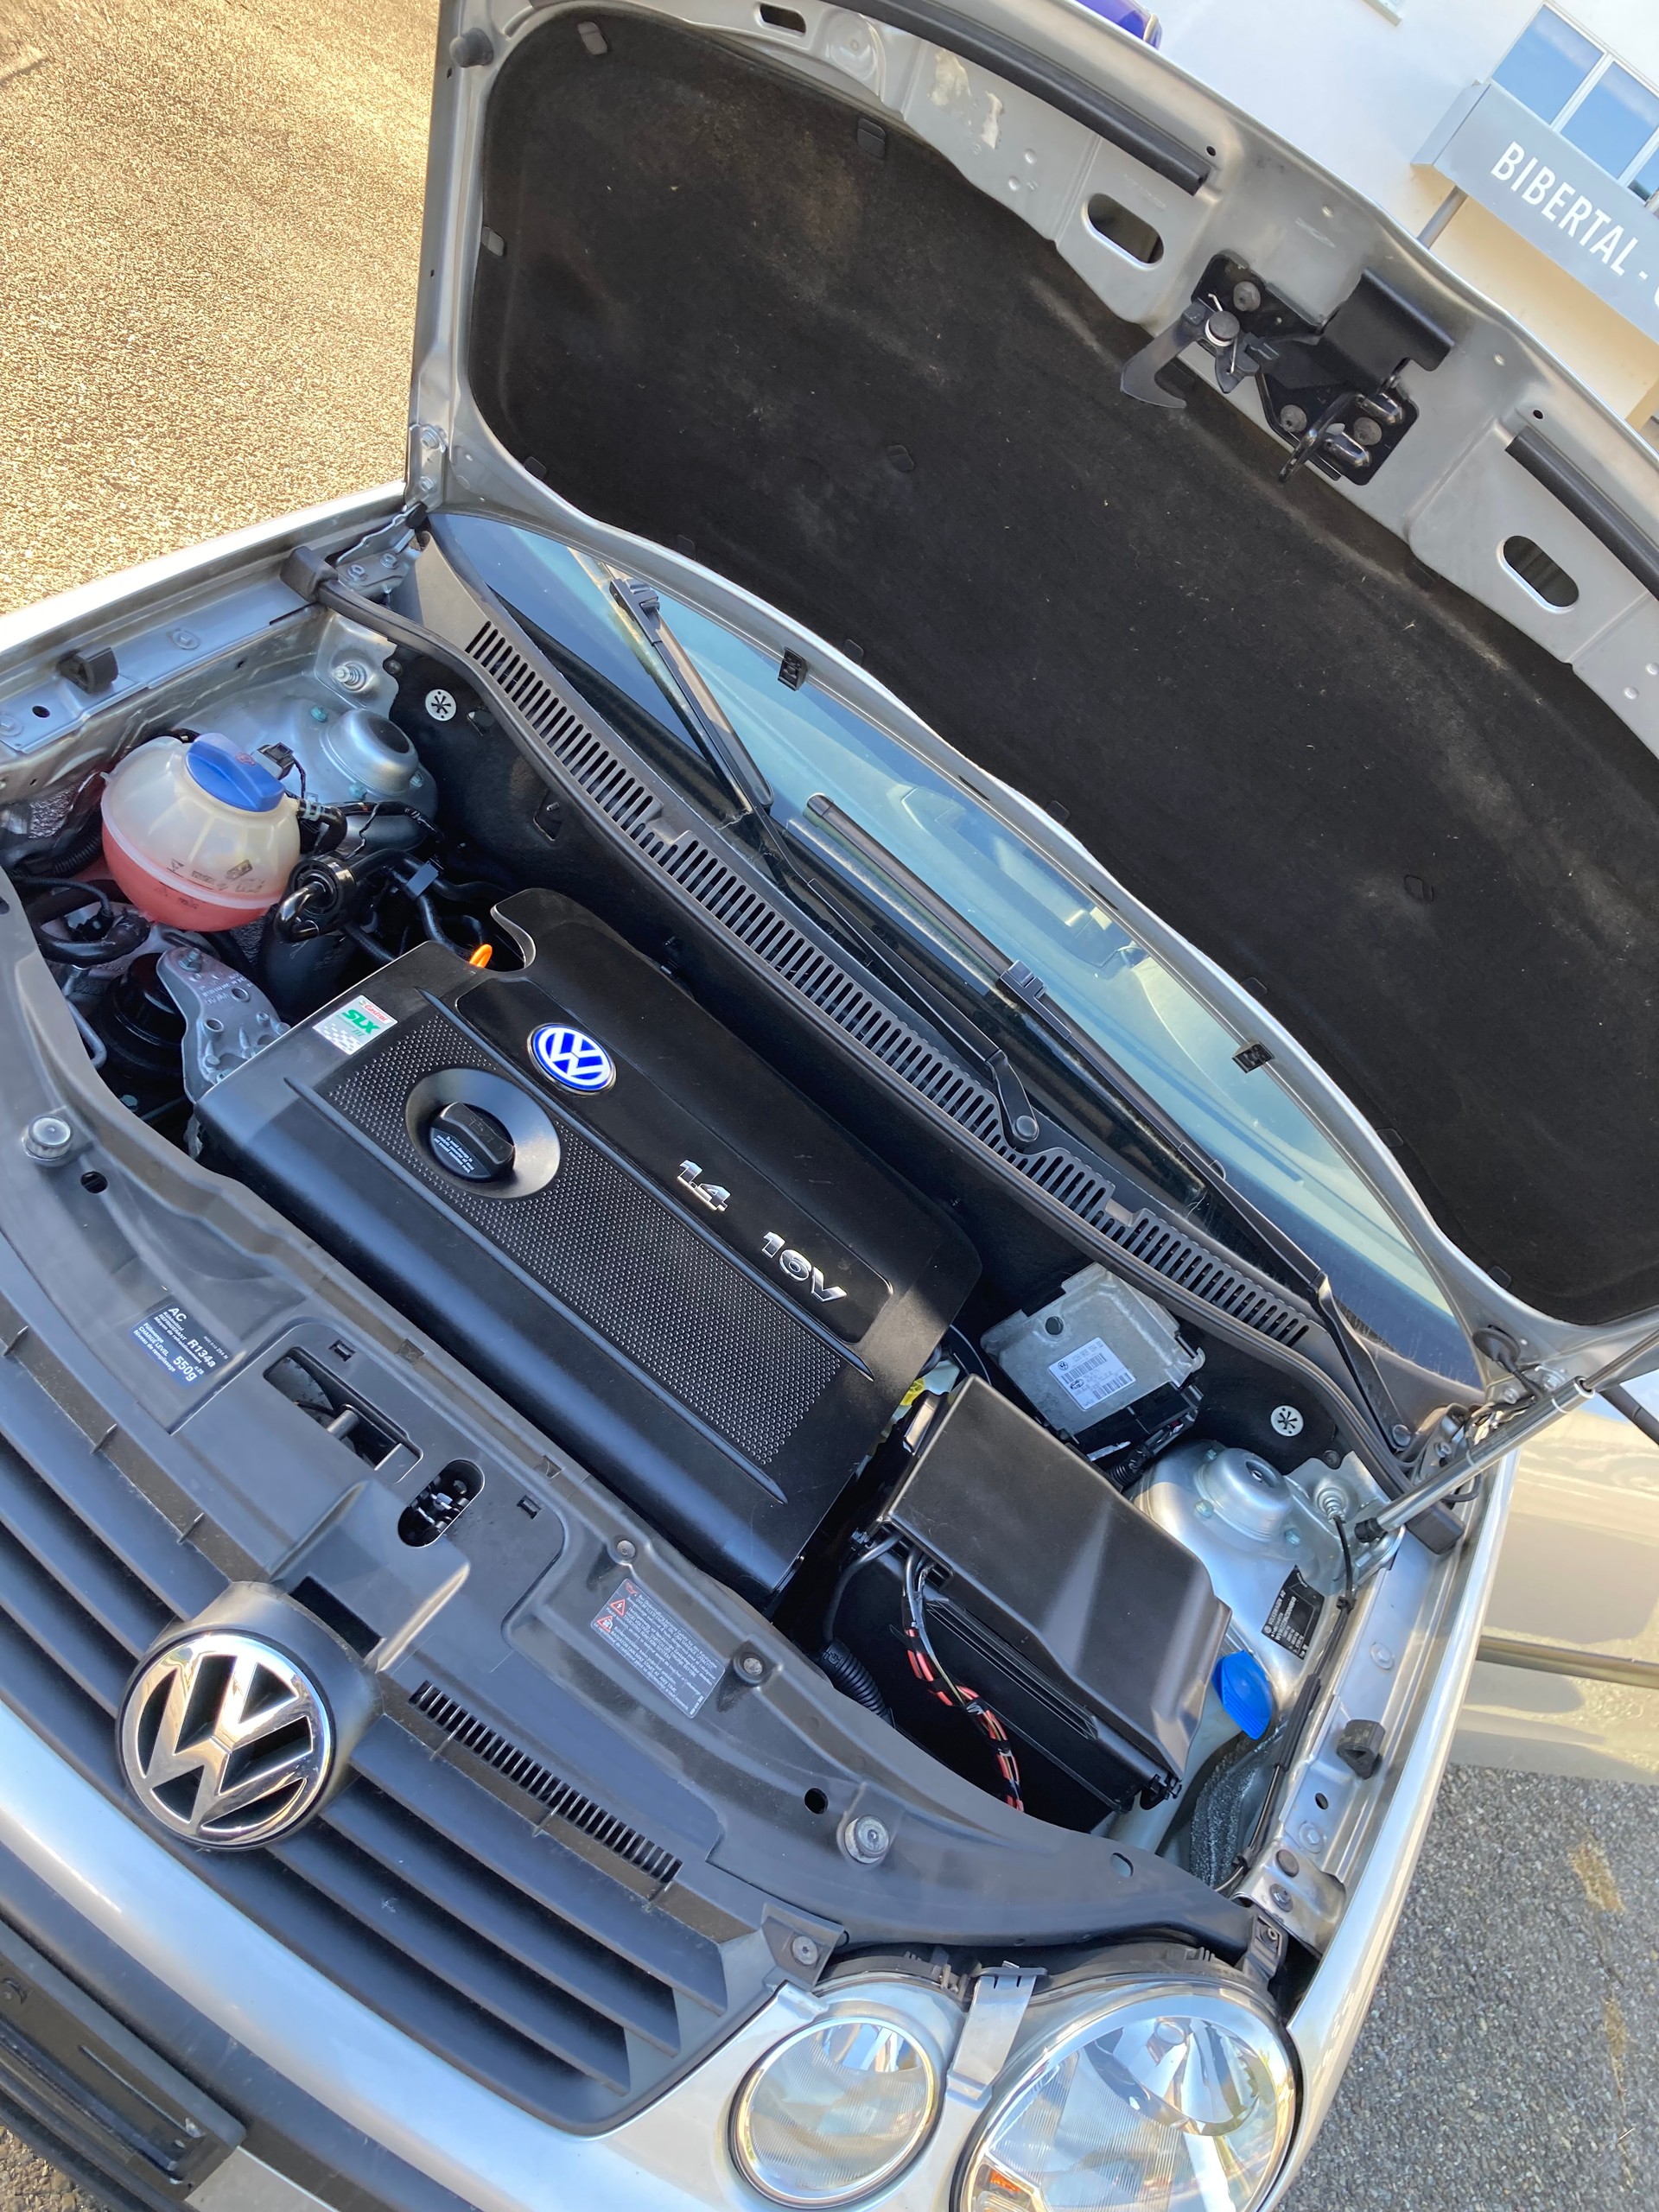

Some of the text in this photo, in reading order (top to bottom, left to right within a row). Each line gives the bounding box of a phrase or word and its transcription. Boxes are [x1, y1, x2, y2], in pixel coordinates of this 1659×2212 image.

[1491, 142, 1638, 276] BIBERTAL
[340, 1007, 380, 1033] SLX
[364, 1003, 388, 1021] Castrol
[677, 1160, 732, 1211] 1.4
[761, 1231, 848, 1303] 16V
[143, 1322, 165, 1343] Füllmenge
[168, 1306, 188, 1320] AC
[132, 1330, 149, 1344] Niveau
[150, 1348, 176, 1372] remplissage
[137, 1325, 200, 1382] CHARGE LEVEL 550g
[152, 1316, 168, 1330] Moyen
[170, 1334, 202, 1363] refroidissement
[157, 1313, 218, 1367] REFRIGERANT R134a
[121, 1633, 333, 1847] VW
